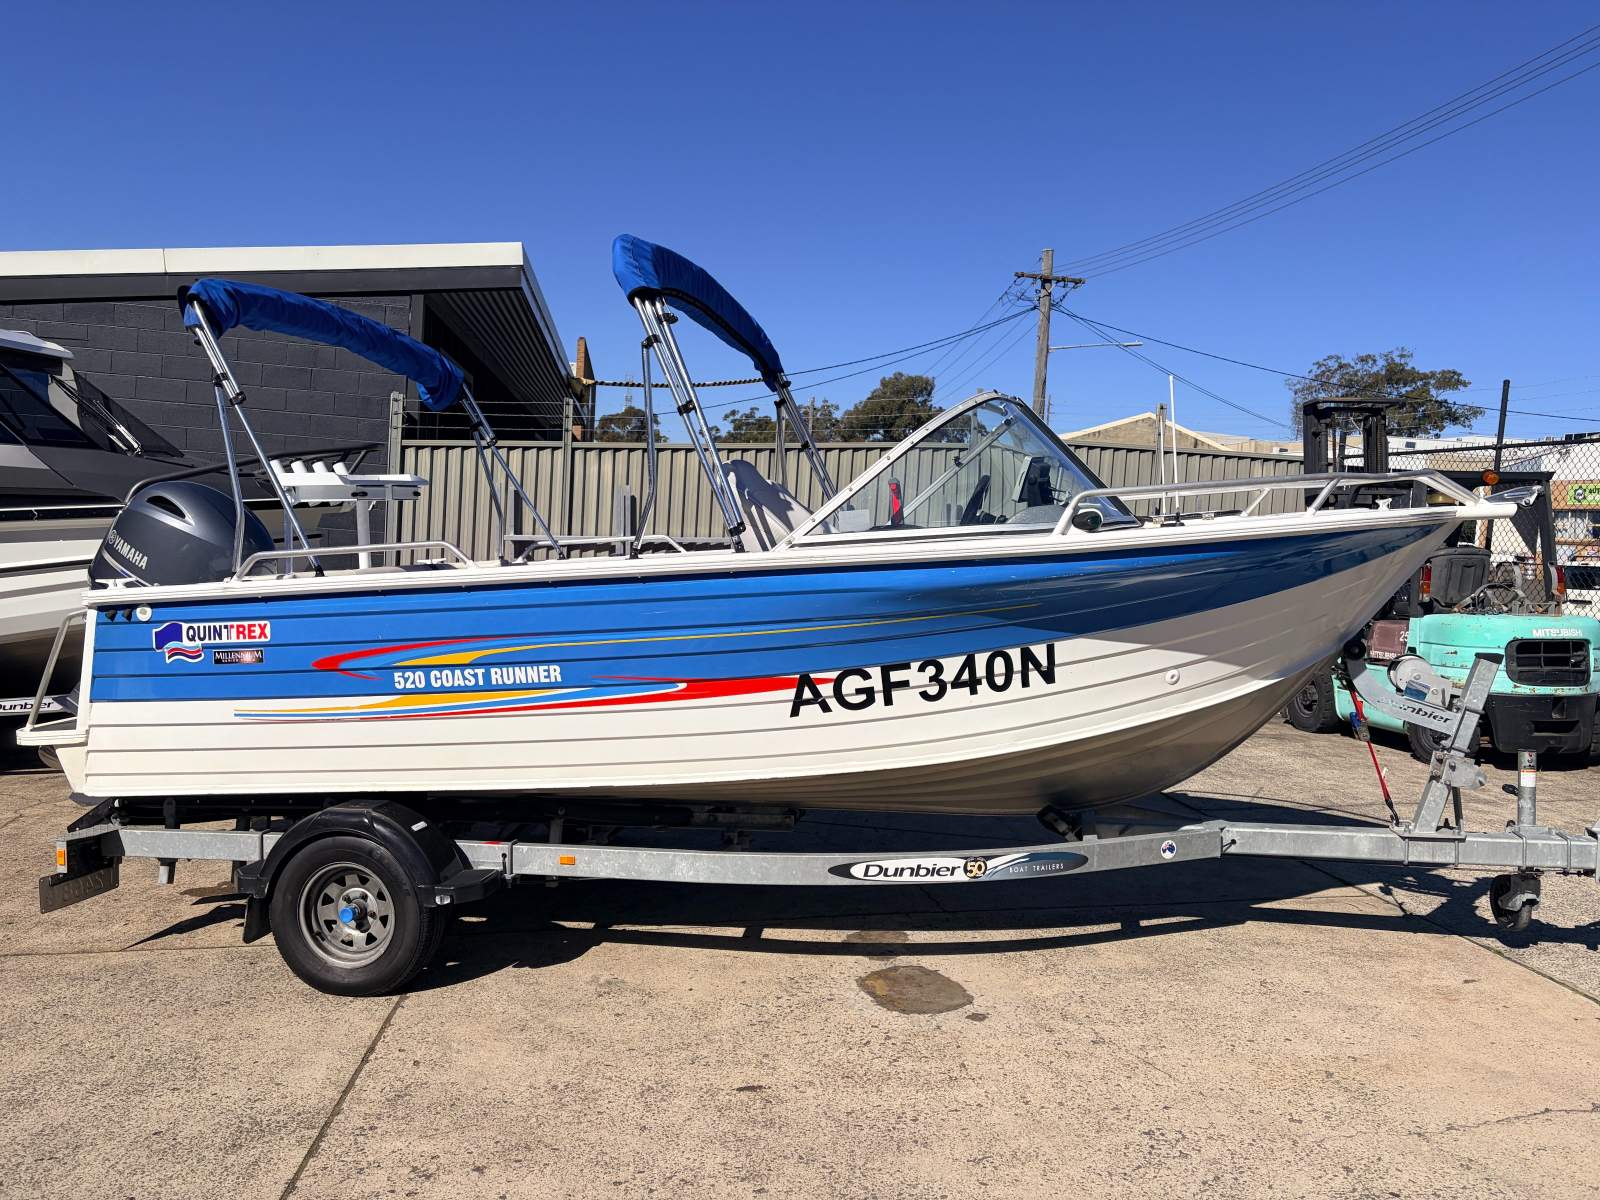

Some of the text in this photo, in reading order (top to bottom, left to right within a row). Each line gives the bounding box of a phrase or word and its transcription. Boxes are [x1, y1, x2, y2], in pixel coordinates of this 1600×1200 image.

[114, 535, 148, 570] YAMAHA
[186, 623, 269, 642] QUINTREX
[1533, 628, 1583, 638] MITSUBISHI
[393, 664, 562, 690] 520 COAST RUNNER
[790, 643, 1056, 718] AGF340N
[863, 863, 960, 878] Dunbier
[966, 861, 986, 878] 50
[1033, 863, 1064, 871] TRAILERS
